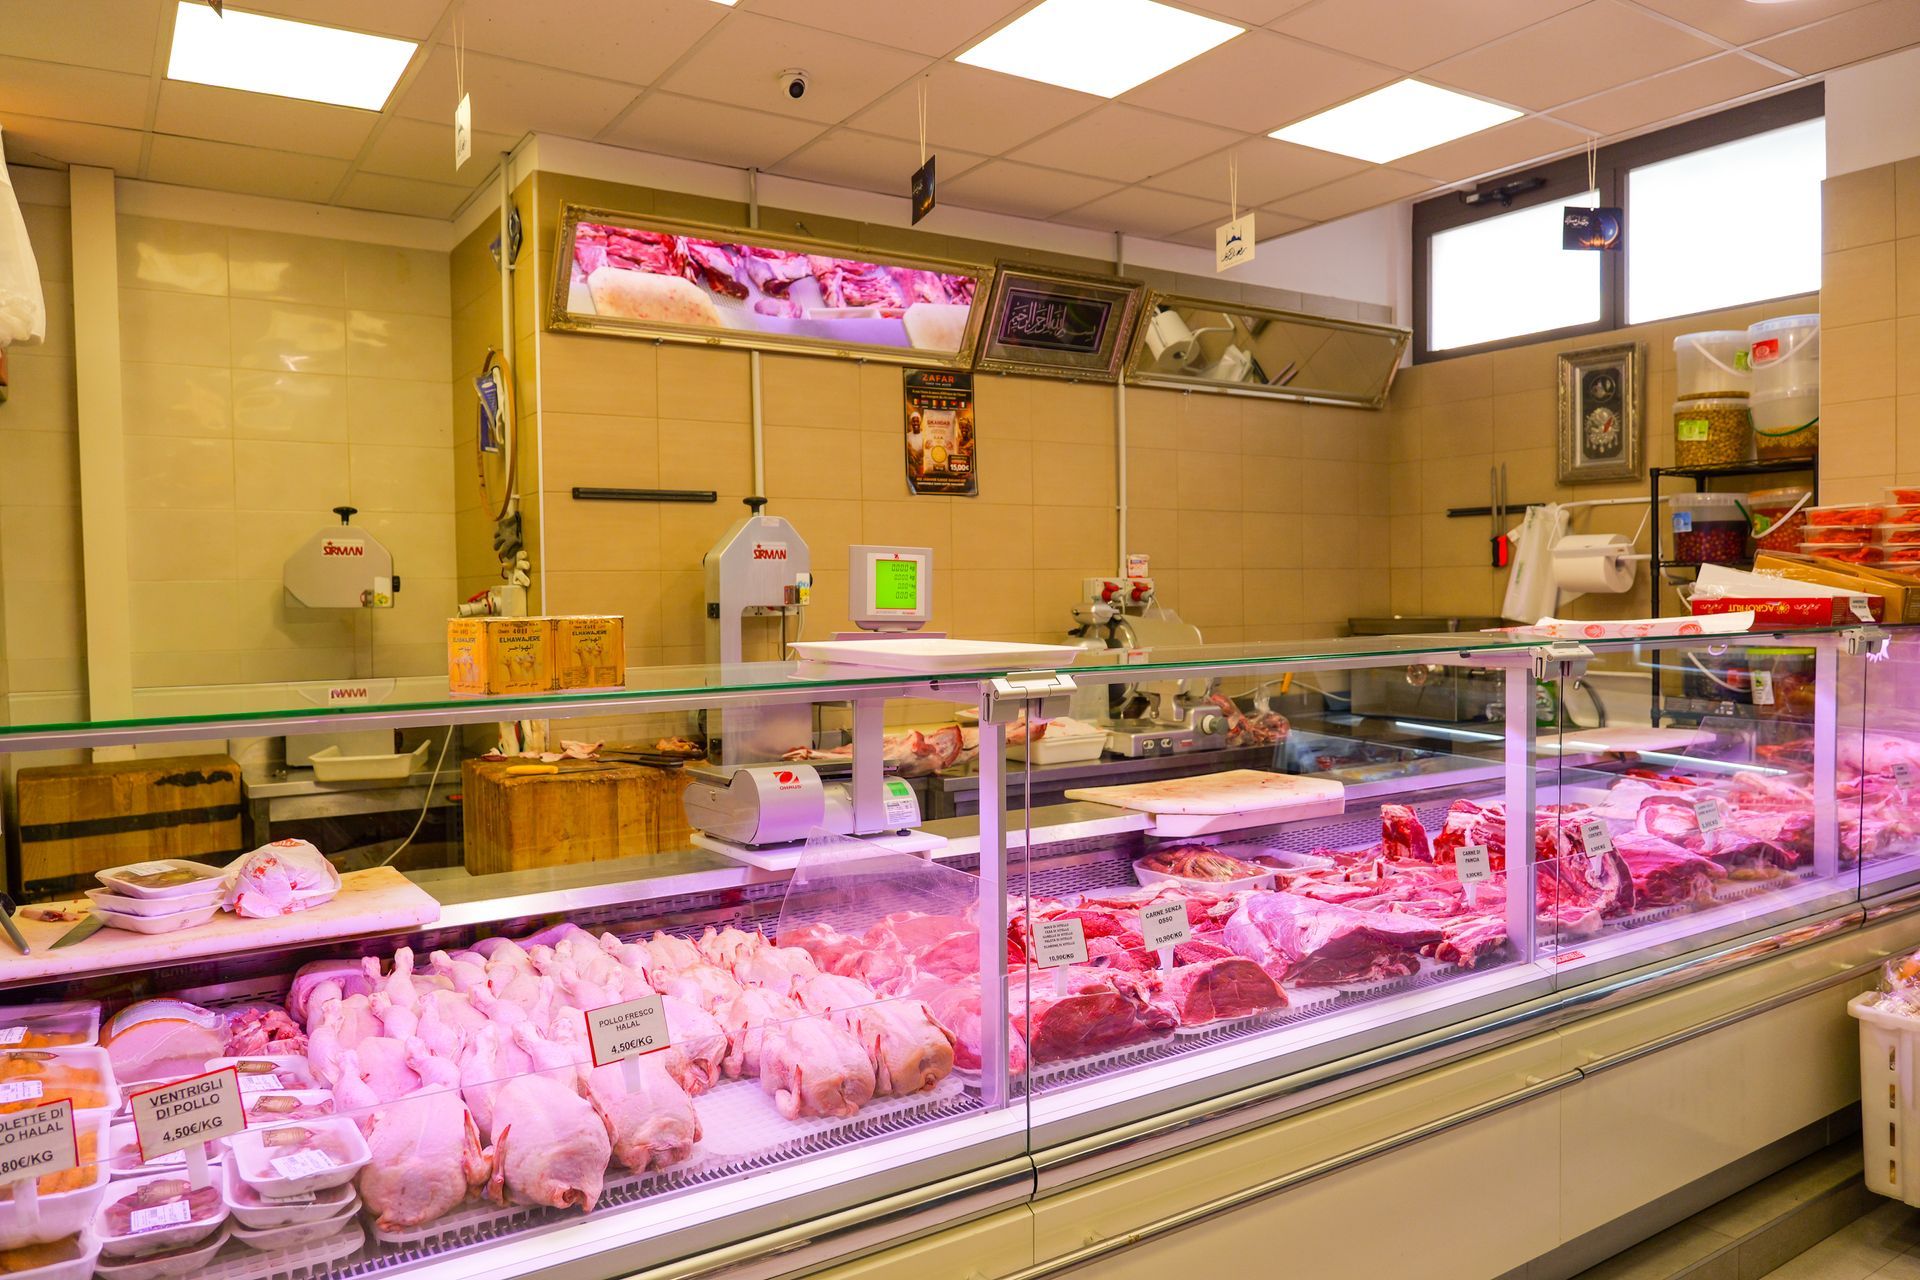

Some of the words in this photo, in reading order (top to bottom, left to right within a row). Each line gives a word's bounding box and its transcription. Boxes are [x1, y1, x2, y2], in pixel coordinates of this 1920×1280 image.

[324, 542, 363, 556] SIRMAN
[753, 545, 787, 560] SIRMAN
[499, 635, 541, 644] ELHAWAJERE
[1145, 910, 1164, 919] CARNE
[1164, 904, 1182, 914] SENZA
[1158, 916, 1173, 925] OSSO
[599, 1015, 624, 1028] POLLO
[624, 1007, 654, 1021] FRESCO
[616, 1020, 640, 1032] HALAL
[611, 1035, 653, 1054] 4,50€/KG
[150, 1078, 223, 1107] VENTRIGLI
[50, 1107, 64, 1119] DI
[156, 1108, 170, 1121] DI
[173, 1093, 220, 1116] POLLO
[19, 1121, 63, 1141] HALAL
[162, 1116, 223, 1142] 4,50€/KG
